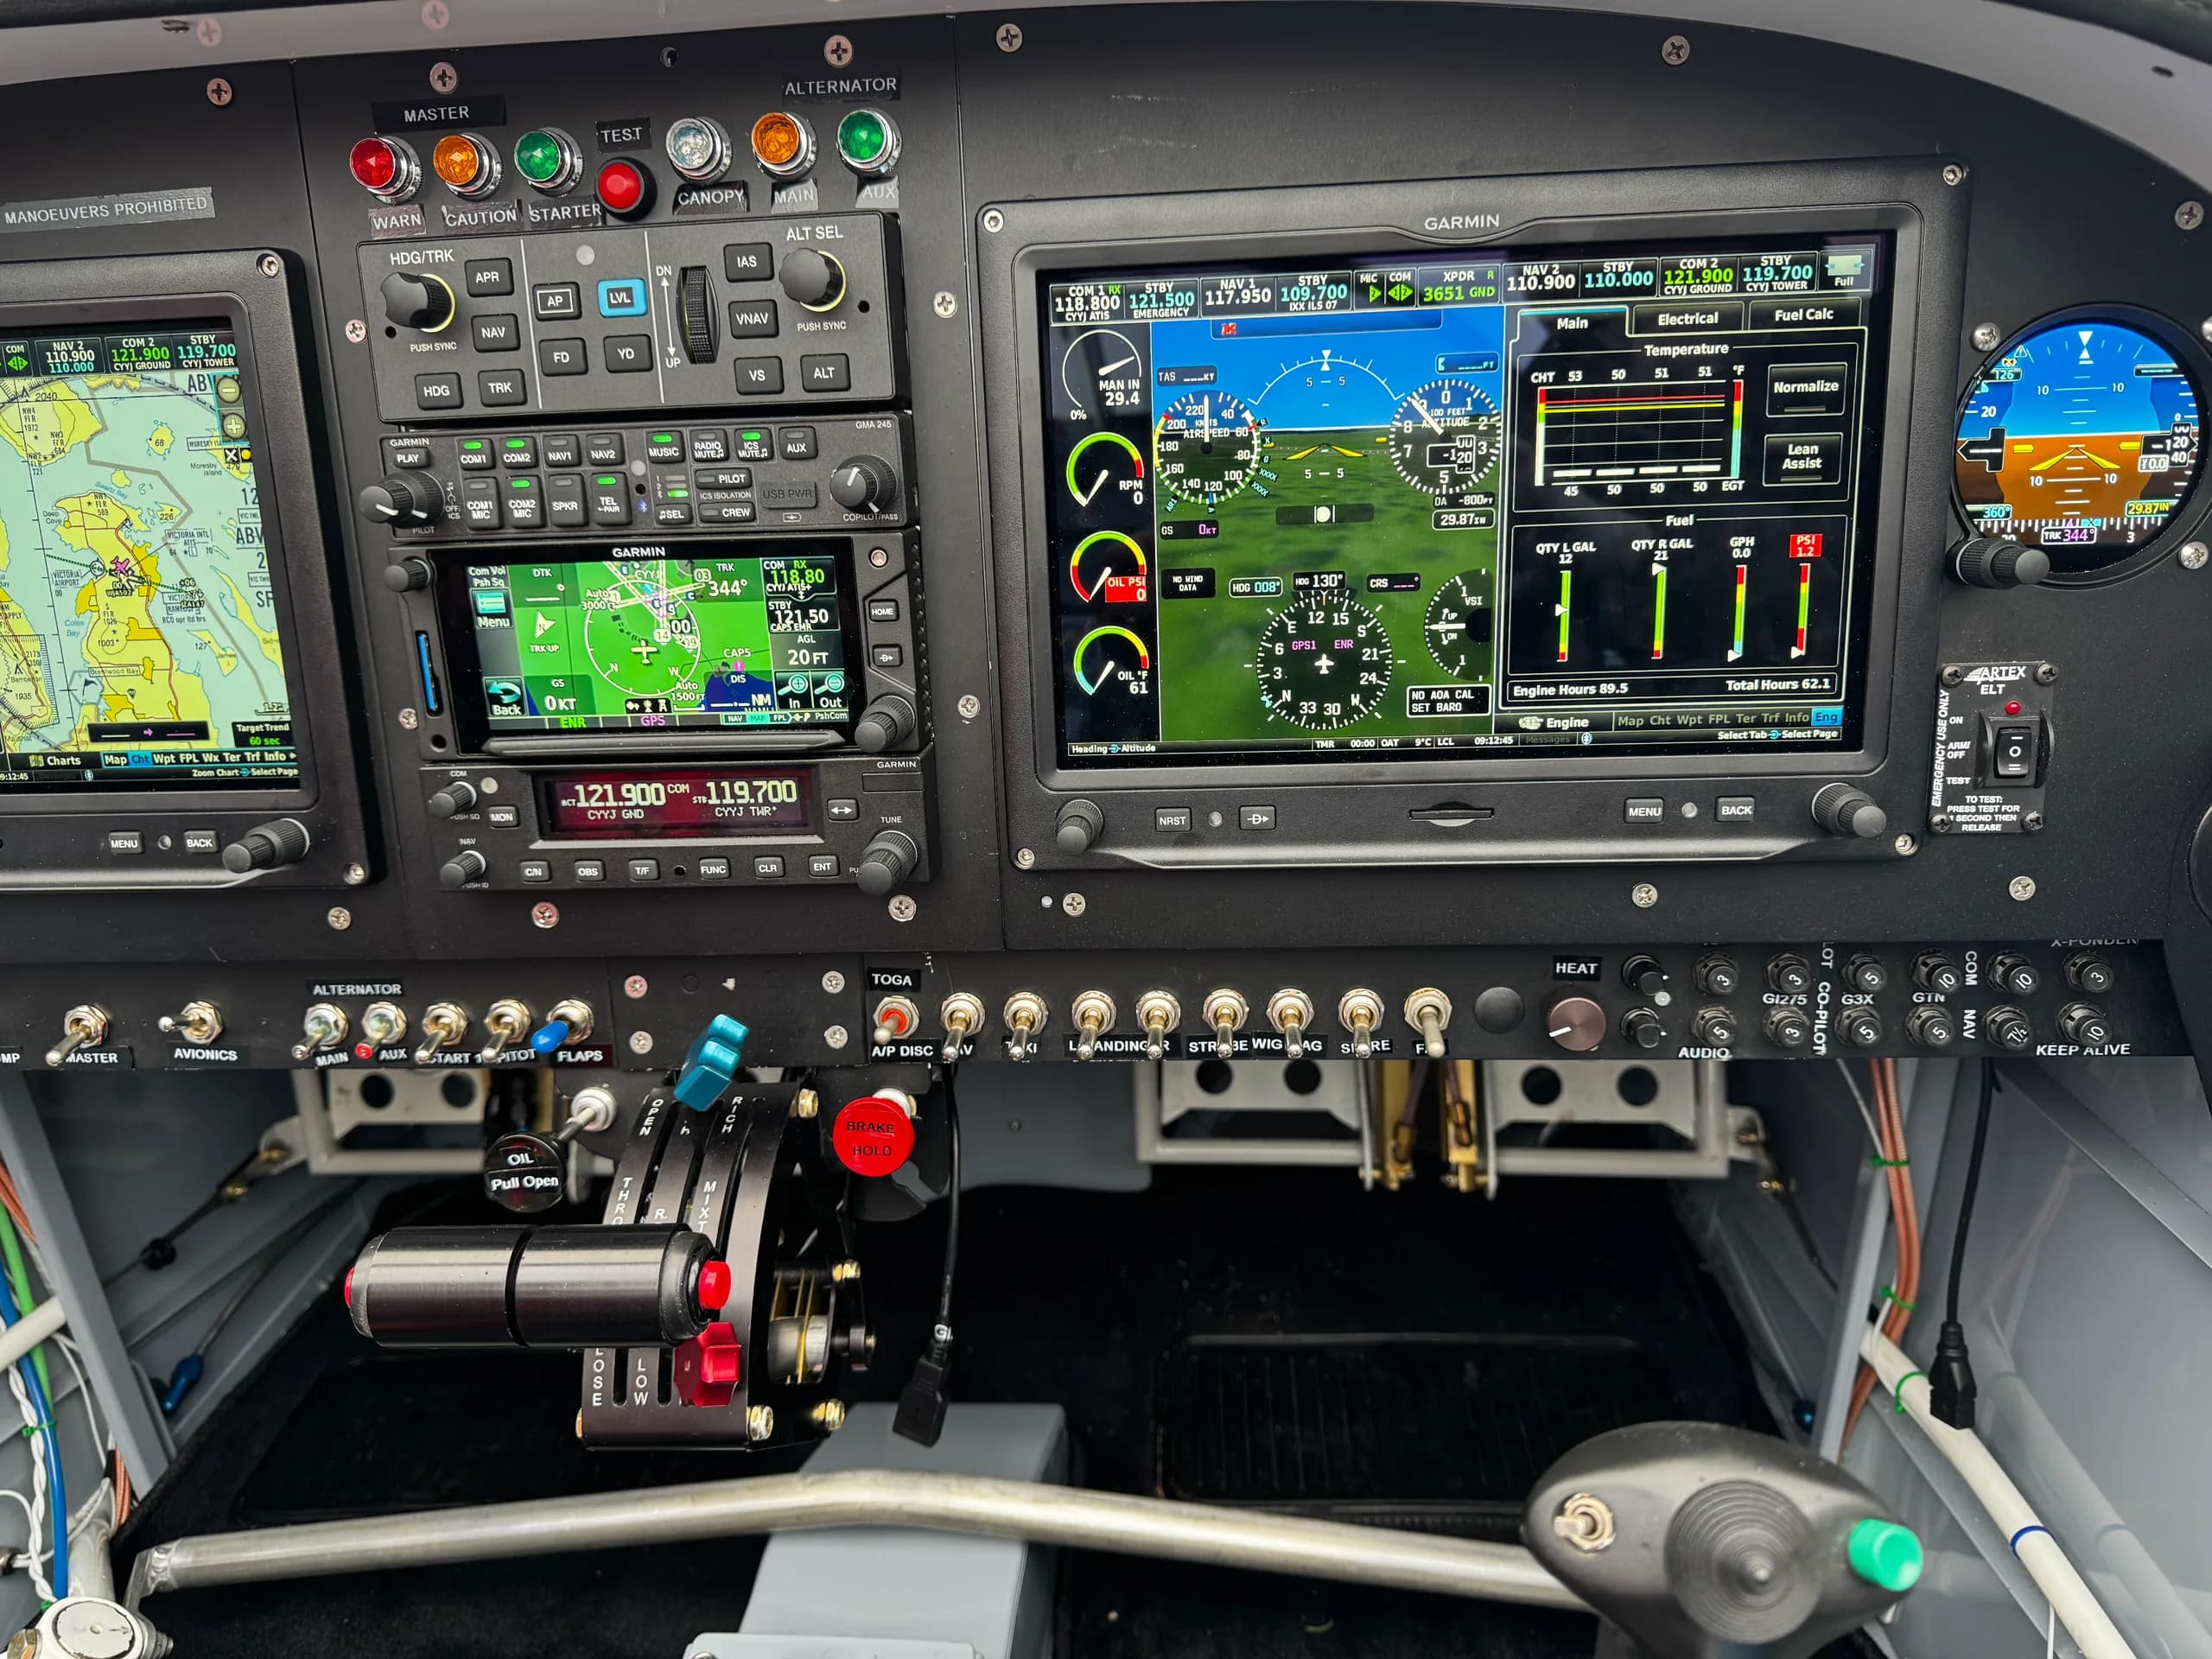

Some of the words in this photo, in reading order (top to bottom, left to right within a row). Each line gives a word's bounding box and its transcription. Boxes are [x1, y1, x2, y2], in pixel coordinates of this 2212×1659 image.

[785, 78, 896, 95] ALTERNATOR
[404, 105, 469, 123] MASTER
[601, 127, 642, 143] TEST
[677, 189, 744, 206] CANOPY
[774, 189, 814, 204] MAIN
[863, 187, 896, 199] AUX
[5, 205, 109, 225] MANOEUVERS
[115, 197, 207, 216] PROHIBITED
[530, 204, 601, 223] STARTER
[372, 214, 422, 231] WARN
[446, 210, 517, 227] CAUTION
[1425, 214, 1500, 230] GARMIN
[787, 227, 811, 241] ALT
[816, 226, 843, 239] SEL
[391, 249, 454, 265] HDG/TRK
[737, 256, 757, 268] IAS
[656, 265, 671, 276] DN
[1443, 270, 1475, 282] XPDR
[1743, 265, 1813, 282] 119.700
[476, 272, 499, 283] APR
[1507, 275, 1576, 291] 110.900
[1585, 271, 1654, 288] 110.000
[1663, 270, 1733, 285] 121.900
[1664, 285, 1688, 296] CYYJ
[1690, 283, 1732, 294] GROUND
[1745, 282, 1769, 292] CYYJ
[1770, 280, 1808, 291] TOWER
[609, 291, 631, 303] LVL
[1205, 289, 1272, 305] 117.950
[1281, 284, 1348, 302] 109.700
[1424, 286, 1464, 302] 3651
[1470, 286, 1495, 297] GND
[547, 296, 563, 307] AP
[1055, 296, 1120, 312] 118.800
[1129, 291, 1194, 308] 121.500
[735, 313, 768, 325] VNAV
[1134, 308, 1189, 319] EMERGENCY
[1775, 308, 1803, 321] Fuel
[1807, 308, 1834, 321] Calc
[1557, 317, 1588, 330] Main
[1658, 313, 1719, 327] Electrical
[481, 327, 505, 338] NAV
[46, 351, 95, 362] 110.900
[111, 347, 169, 362] 121.900
[177, 345, 237, 358] 119.700
[1645, 343, 1729, 358] Temperature
[553, 352, 569, 363] FD
[748, 370, 766, 381] VS
[813, 367, 835, 379] ALT
[1531, 372, 1555, 383] CHT
[1994, 370, 2014, 379] 126
[488, 382, 512, 394] TRK
[1099, 379, 1124, 391] MAN
[1128, 378, 1140, 389] IN
[1773, 381, 1839, 393] Normalize
[423, 386, 449, 397] HDG
[1105, 391, 1140, 406] 29.4
[390, 438, 429, 447] GARMIN
[786, 443, 806, 453] AUX
[591, 450, 615, 460] NAV2
[649, 448, 679, 457] MUSIC
[1788, 443, 1818, 455] Lean
[397, 454, 419, 464] PLAY
[461, 454, 486, 465] COM1
[504, 454, 531, 463] COM2
[548, 452, 571, 461] NAV1
[1783, 457, 1821, 470] Assist
[719, 474, 746, 484] PILOT
[1119, 480, 1143, 490] RPM
[1722, 480, 1745, 492] EGT
[763, 489, 785, 499] USB
[788, 488, 812, 498] PWR
[552, 501, 577, 511] SPKR
[722, 508, 750, 517] CREW
[1666, 515, 1694, 527] Fuel
[1730, 536, 1754, 547] GPH
[1796, 536, 1815, 546] PSI
[612, 546, 665, 557] GARMIN
[1796, 547, 1814, 556] 1.2
[771, 569, 824, 584] 118.80
[477, 617, 510, 627] Menu
[775, 610, 829, 624] 121.50
[797, 634, 816, 644] AGL
[1292, 641, 1317, 650] GPS1
[788, 650, 810, 665] 20
[812, 652, 828, 664] FT
[1981, 666, 2026, 677] ARTEX
[1129, 682, 1148, 694] 61
[1513, 685, 1555, 697] Engine
[1559, 684, 1596, 696] Hours
[1599, 683, 1629, 695] 89.5
[1726, 679, 1758, 691] Total
[1761, 678, 1798, 690] Hours
[1802, 677, 1830, 690] 62.1
[1980, 684, 2005, 695] ELT
[1412, 691, 1425, 700] NO
[1431, 690, 1449, 700] AOA
[1455, 690, 1474, 698] CAL
[819, 696, 842, 709] Out
[1412, 702, 1433, 712] SET
[1437, 702, 1462, 711] BARO
[1939, 690, 1949, 717] ONLY
[492, 704, 521, 715] Back
[1546, 715, 1590, 728] Engine
[1815, 710, 1838, 725] Eng
[1938, 718, 1947, 740] USE
[1072, 745, 1108, 754] Heading
[1122, 744, 1155, 753] Altitude
[47, 755, 81, 766] Charts
[1932, 744, 1946, 806] EMERGENCY
[575, 783, 666, 808] 121.900
[706, 780, 797, 804] 119.700
[588, 810, 616, 820] CYYJ
[622, 809, 644, 819] GND
[1629, 807, 1662, 817] MENU
[1721, 805, 1752, 816] BACK
[1160, 817, 1185, 825] NRST
[111, 839, 137, 849] MENU
[187, 837, 213, 849] BACK
[701, 865, 727, 874] FUNC
[759, 864, 777, 874] CLR
[1556, 963, 1597, 974] HEAT
[1965, 951, 1977, 986] COM
[872, 974, 912, 986] TOGA
[314, 984, 402, 995] ALTERNATOR
[1763, 995, 1808, 1005] GI275
[1841, 994, 1874, 1006] G3X
[1912, 992, 1945, 1003] GTN
[1813, 982, 1831, 1055] CO-PILOT
[1963, 1009, 1975, 1039] NAV
[174, 1049, 238, 1061] AVIONICS
[872, 1045, 895, 1057] A/P
[900, 1045, 933, 1056] DISC
[1678, 1047, 1729, 1059] AUDIO
[2036, 1045, 2079, 1056] KEEP
[2083, 1044, 2131, 1055] ALIVE
[557, 1051, 603, 1062] FLAPS
[847, 1122, 895, 1133] BRAKE
[854, 1146, 892, 1156] HOLD
[507, 1153, 535, 1166] OIL
[491, 1176, 520, 1191] Pull
[523, 1175, 559, 1188] Open
